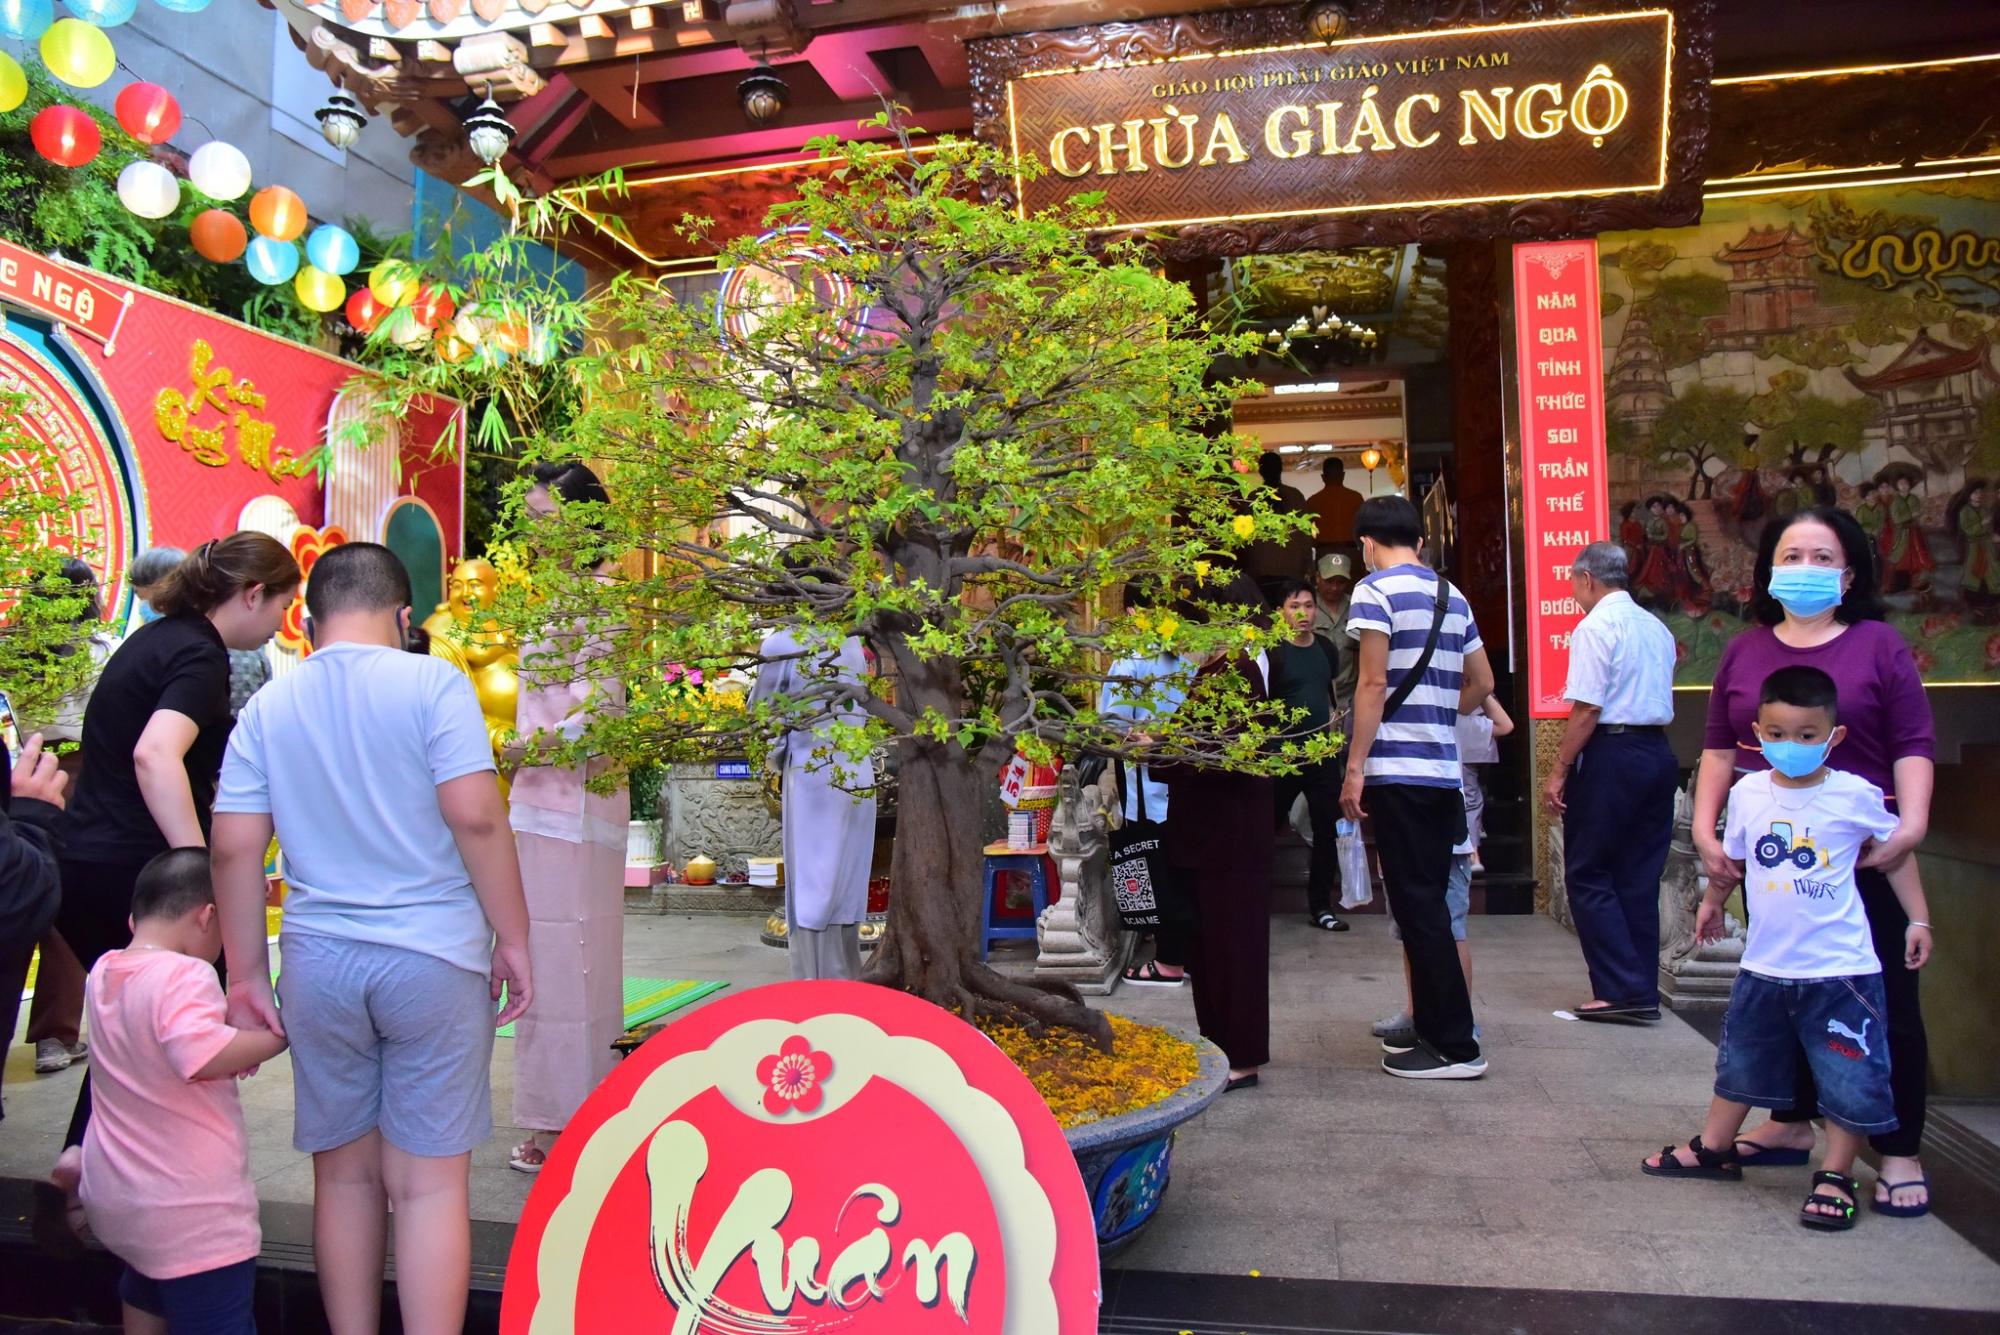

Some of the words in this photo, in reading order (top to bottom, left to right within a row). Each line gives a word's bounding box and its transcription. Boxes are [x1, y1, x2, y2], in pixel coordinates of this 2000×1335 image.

[1152, 78, 1208, 98] GIÁO
[1216, 73, 1255, 94] HỘI
[1263, 67, 1322, 88] PHẬT
[1330, 62, 1388, 82] GIÁO
[1395, 56, 1450, 76] VIỆT
[1456, 51, 1511, 69] NAM
[1049, 103, 1250, 178] CHÙA
[1264, 84, 1441, 160] GIÁC
[1458, 63, 1629, 149] NGỘ
[31, 269, 95, 325] NGỘ
[1536, 290, 1577, 310] NĂM
[1539, 326, 1578, 346] QUA
[1535, 390, 1586, 411] THỨC
[1547, 428, 1579, 445] SOI
[1538, 456, 1589, 480] TRẦN
[1546, 490, 1585, 513] THẾ
[1543, 530, 1591, 547] KHAI
[1123, 839, 1160, 857] SECRET
[646, 1119, 973, 1335] Xuân
